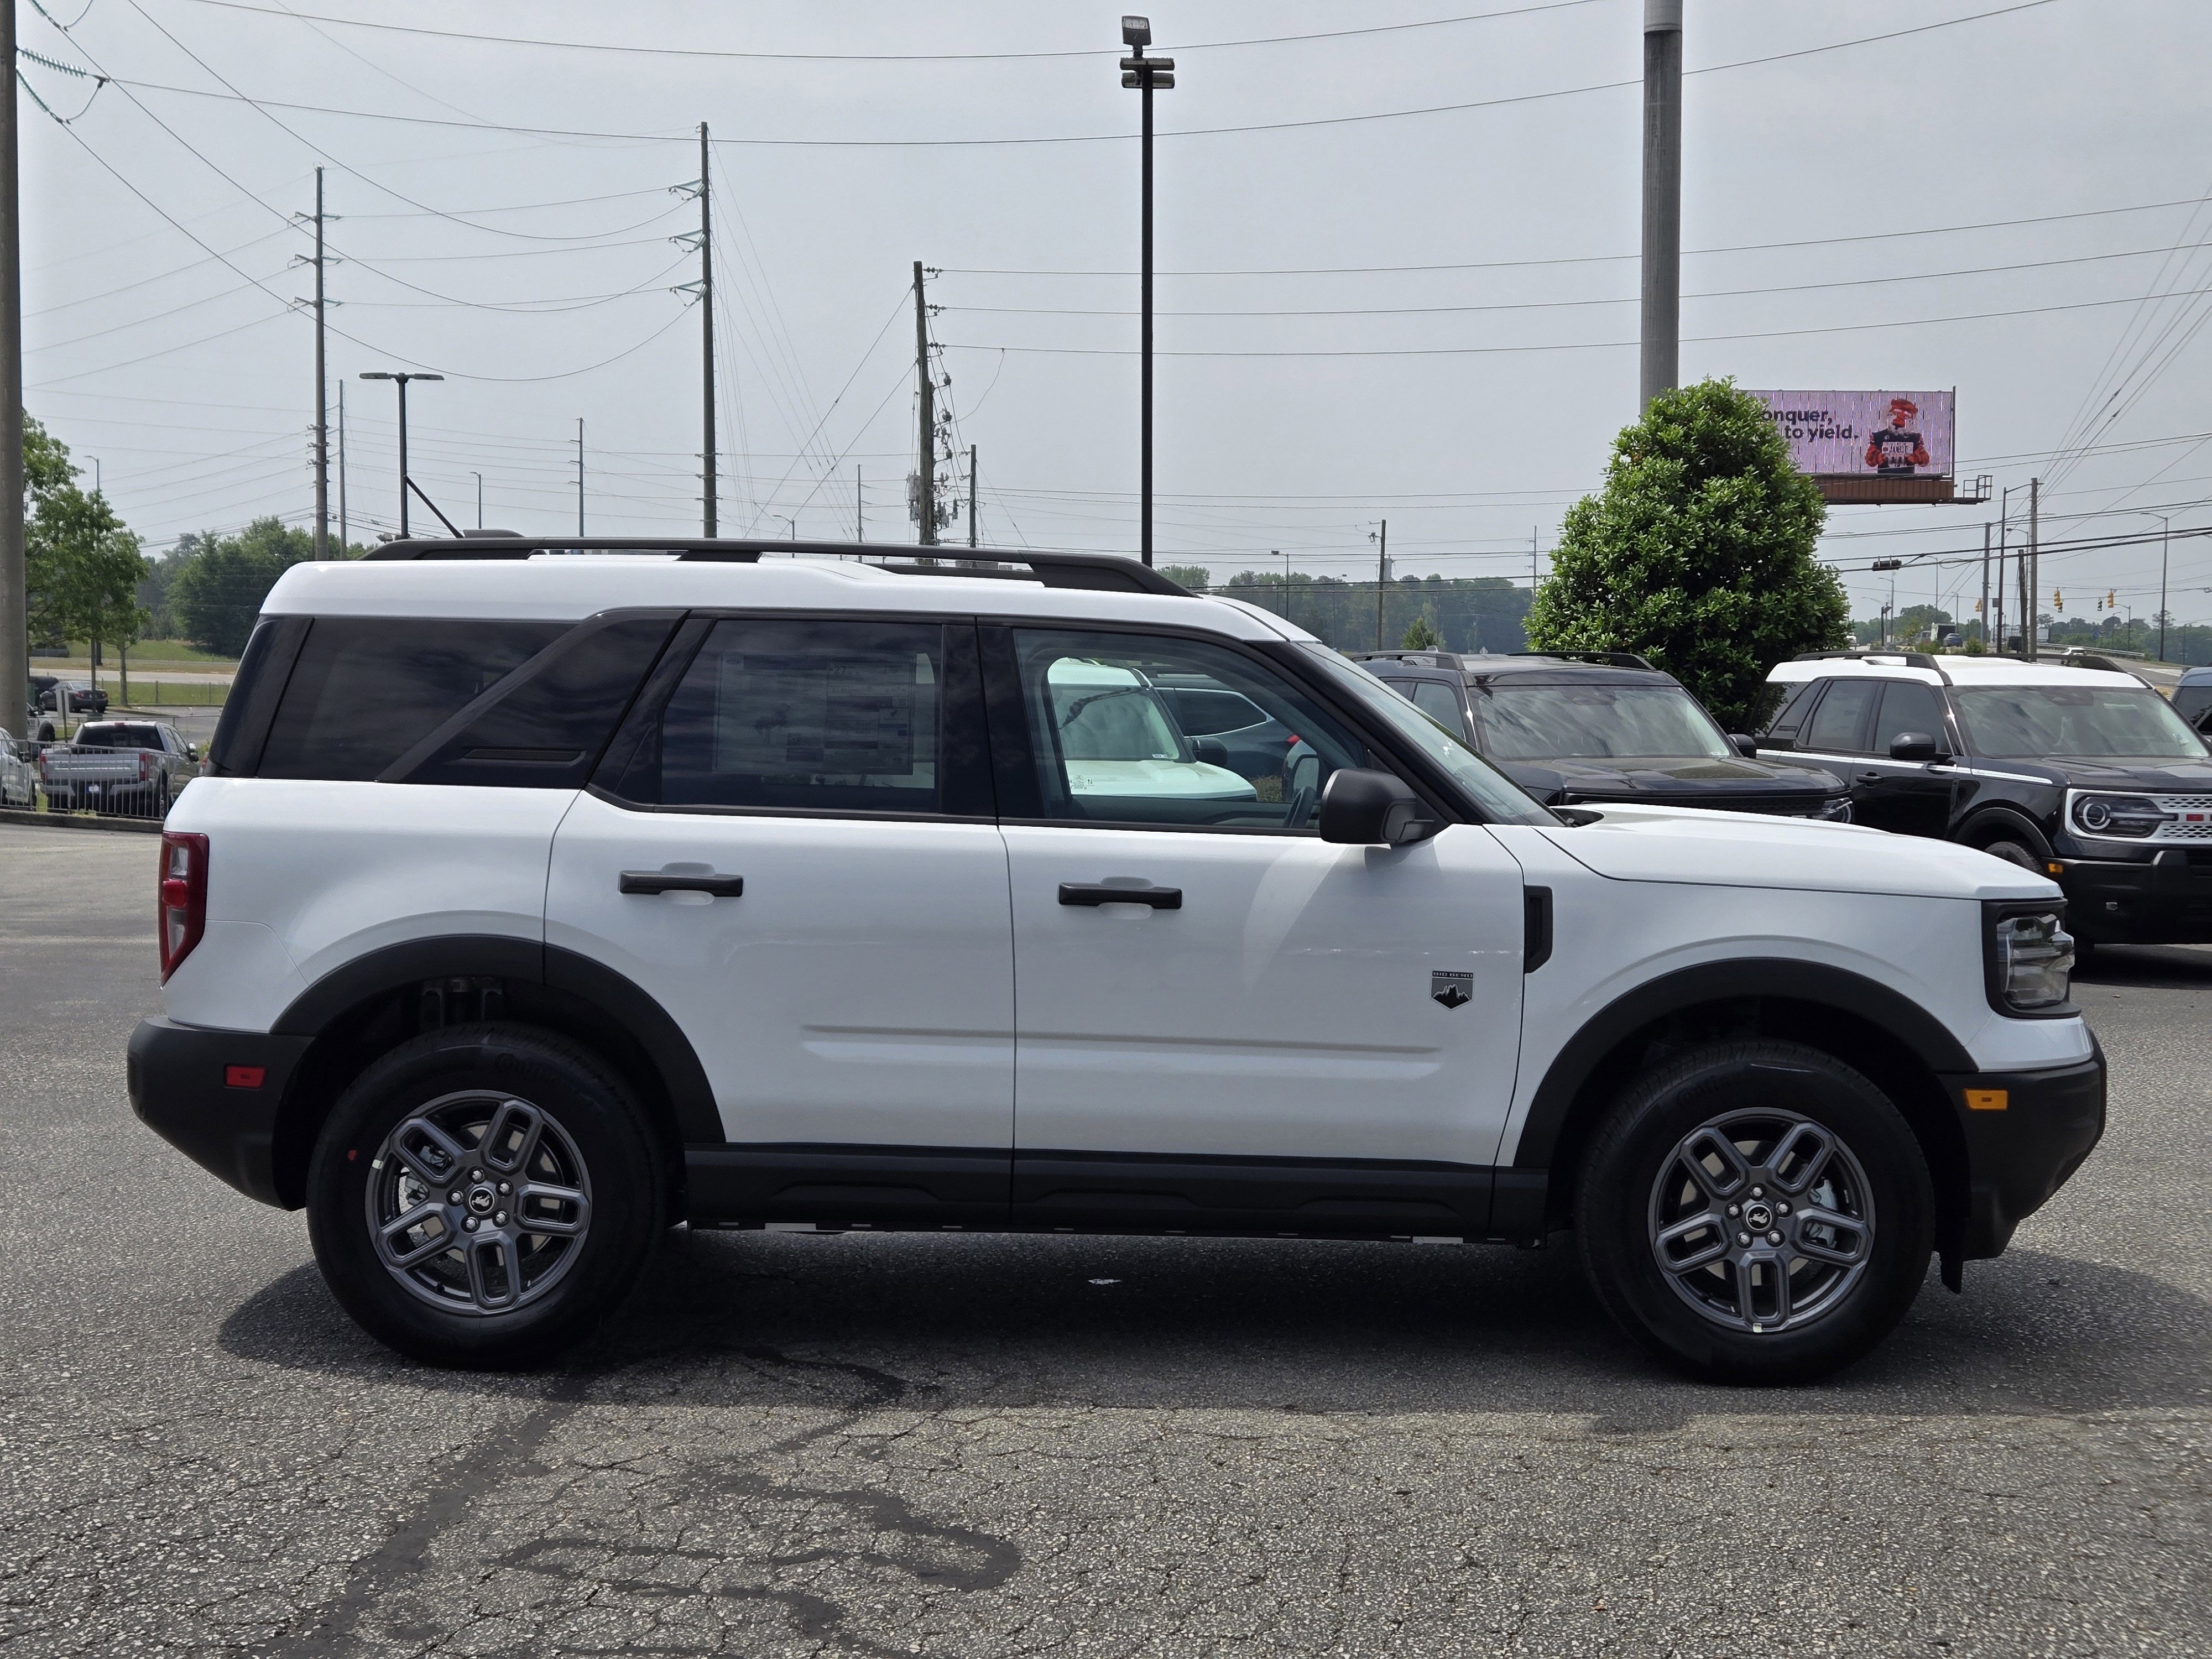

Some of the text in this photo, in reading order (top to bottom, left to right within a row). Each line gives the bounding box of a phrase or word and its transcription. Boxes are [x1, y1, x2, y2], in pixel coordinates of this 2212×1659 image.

[1762, 410, 1833, 425] onquer,
[1785, 424, 1859, 442] to yield.
